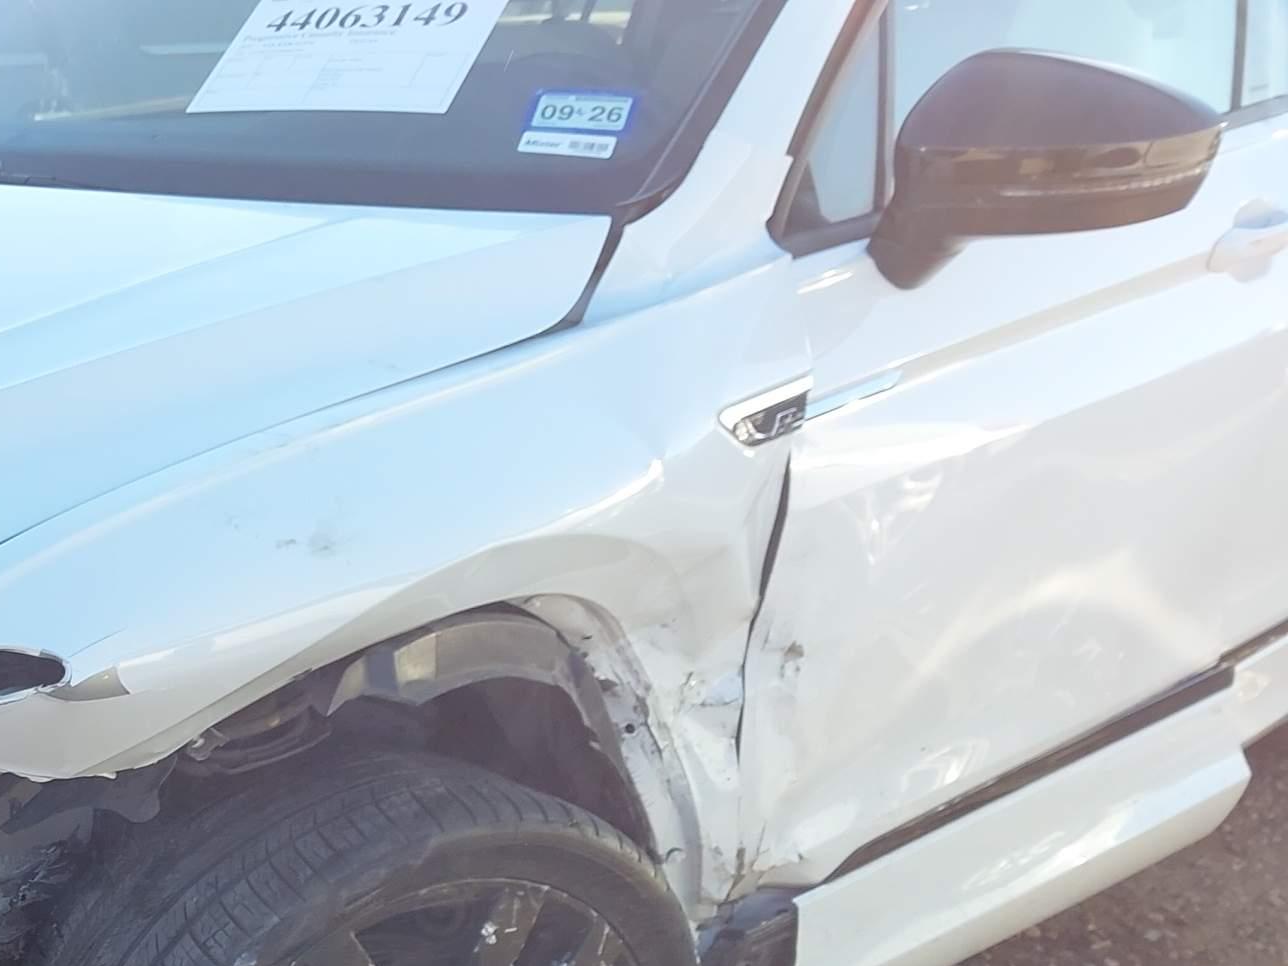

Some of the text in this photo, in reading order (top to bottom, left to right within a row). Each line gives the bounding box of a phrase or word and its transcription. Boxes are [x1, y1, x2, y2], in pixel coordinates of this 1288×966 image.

[266, 1, 469, 32] 44063149
[540, 104, 625, 123] 09 26
